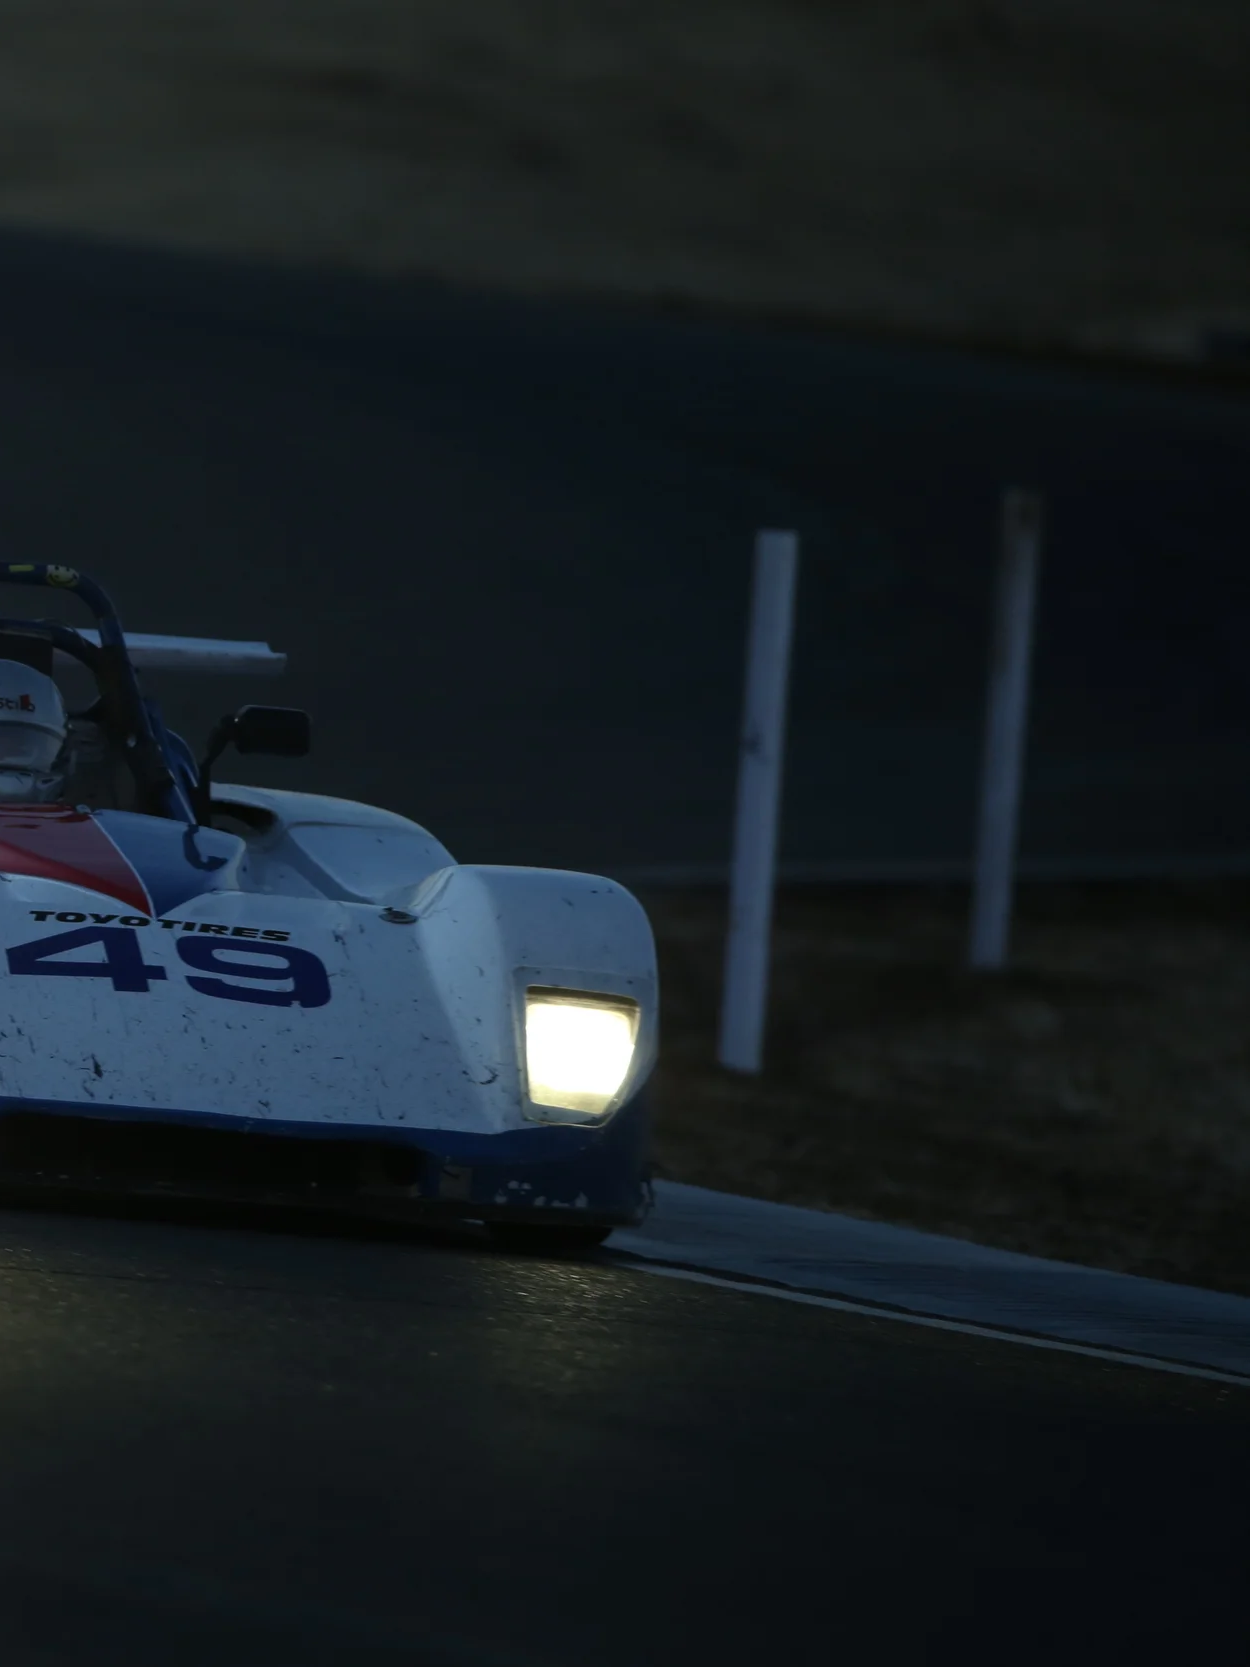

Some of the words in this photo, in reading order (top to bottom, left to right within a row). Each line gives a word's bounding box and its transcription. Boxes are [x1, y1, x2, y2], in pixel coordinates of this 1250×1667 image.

[29, 910, 150, 926] TOYO
[157, 918, 291, 942] TIRES
[6, 925, 332, 1008] 49
